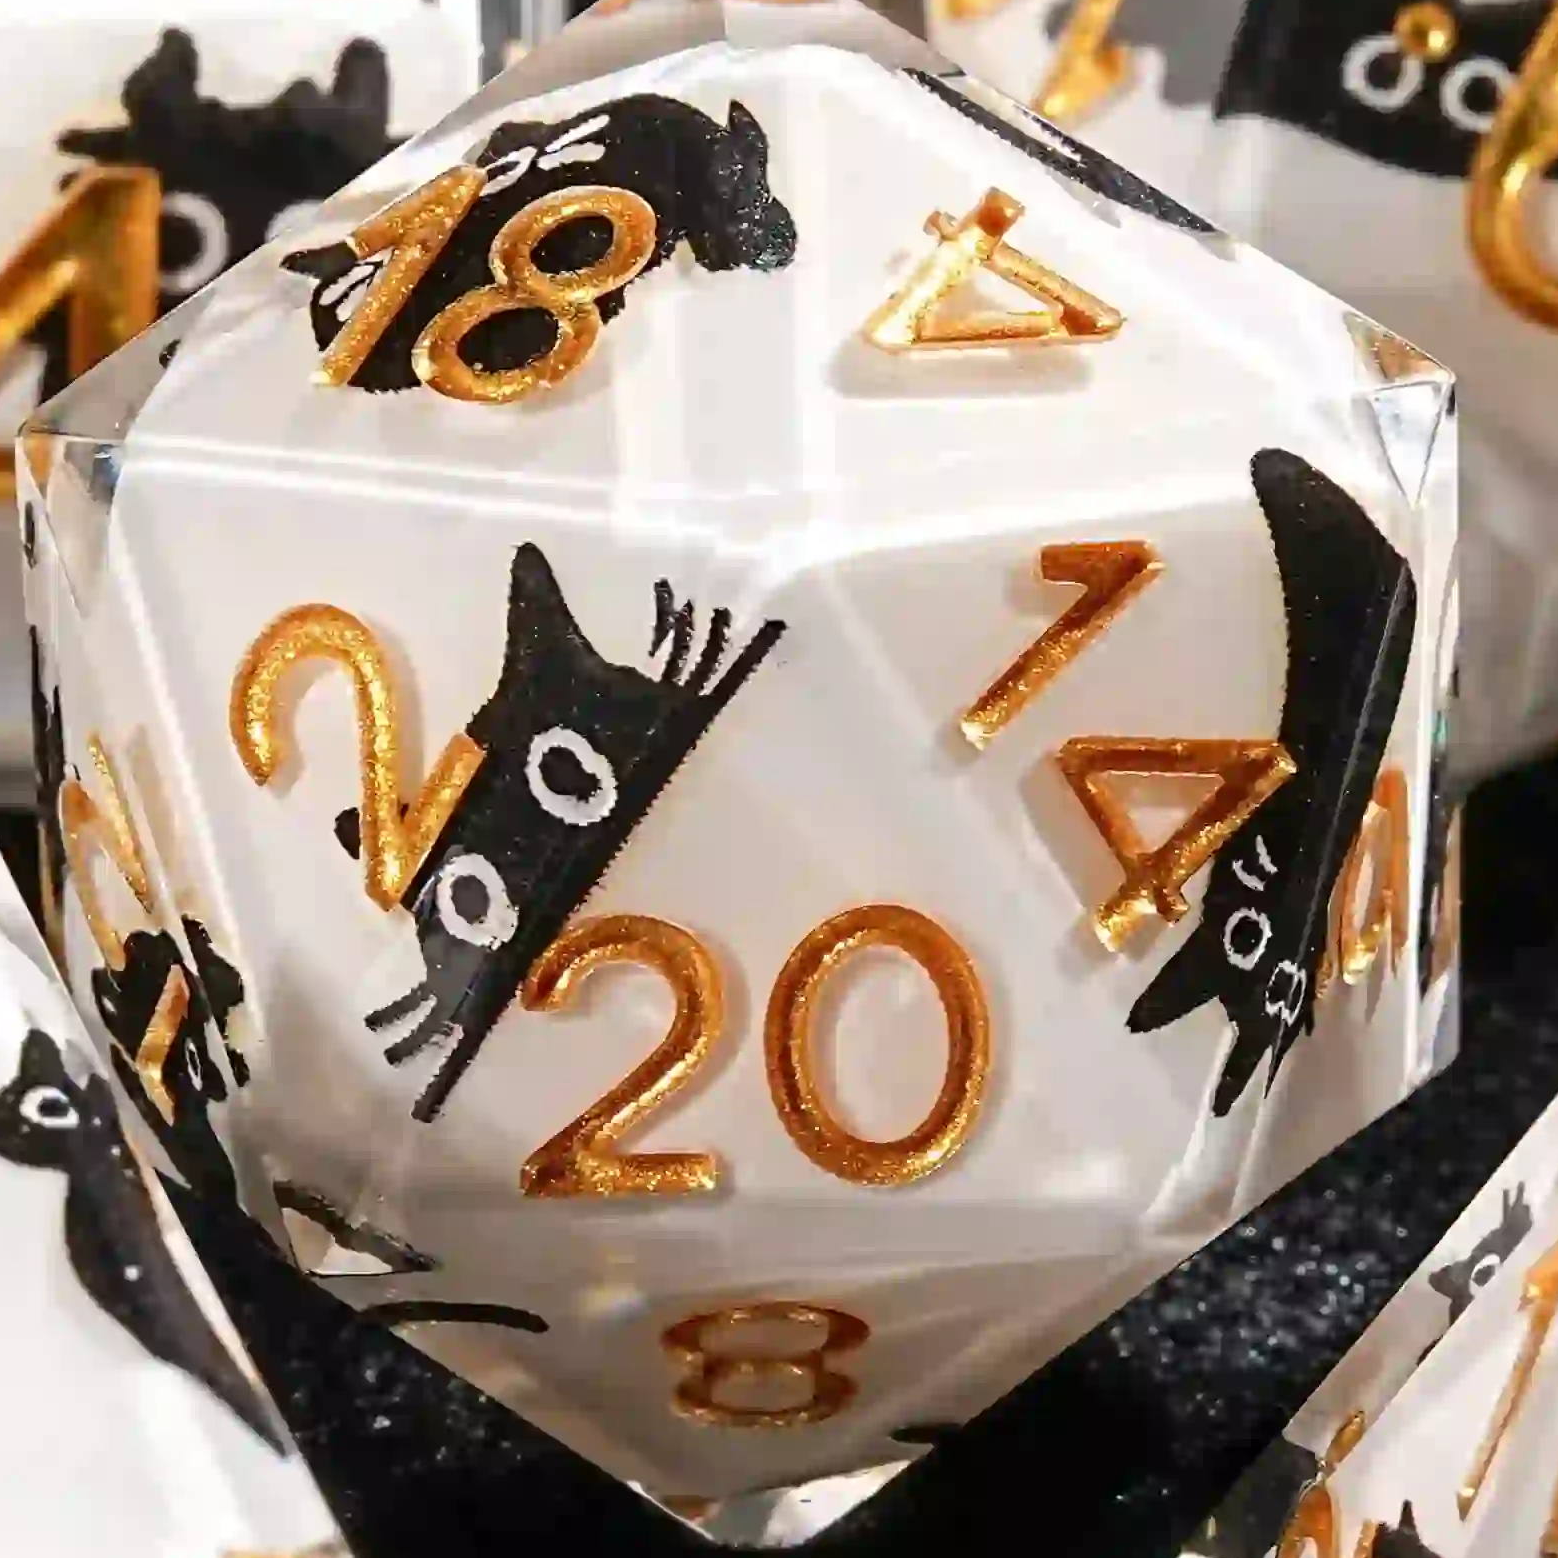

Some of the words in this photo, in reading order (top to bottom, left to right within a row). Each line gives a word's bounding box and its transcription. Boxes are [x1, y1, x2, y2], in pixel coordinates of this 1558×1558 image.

[307, 165, 657, 405] 18
[863, 185, 1125, 349] 4
[229, 603, 489, 917] 2
[959, 539, 1299, 955] 14
[519, 903, 993, 1199] 20
